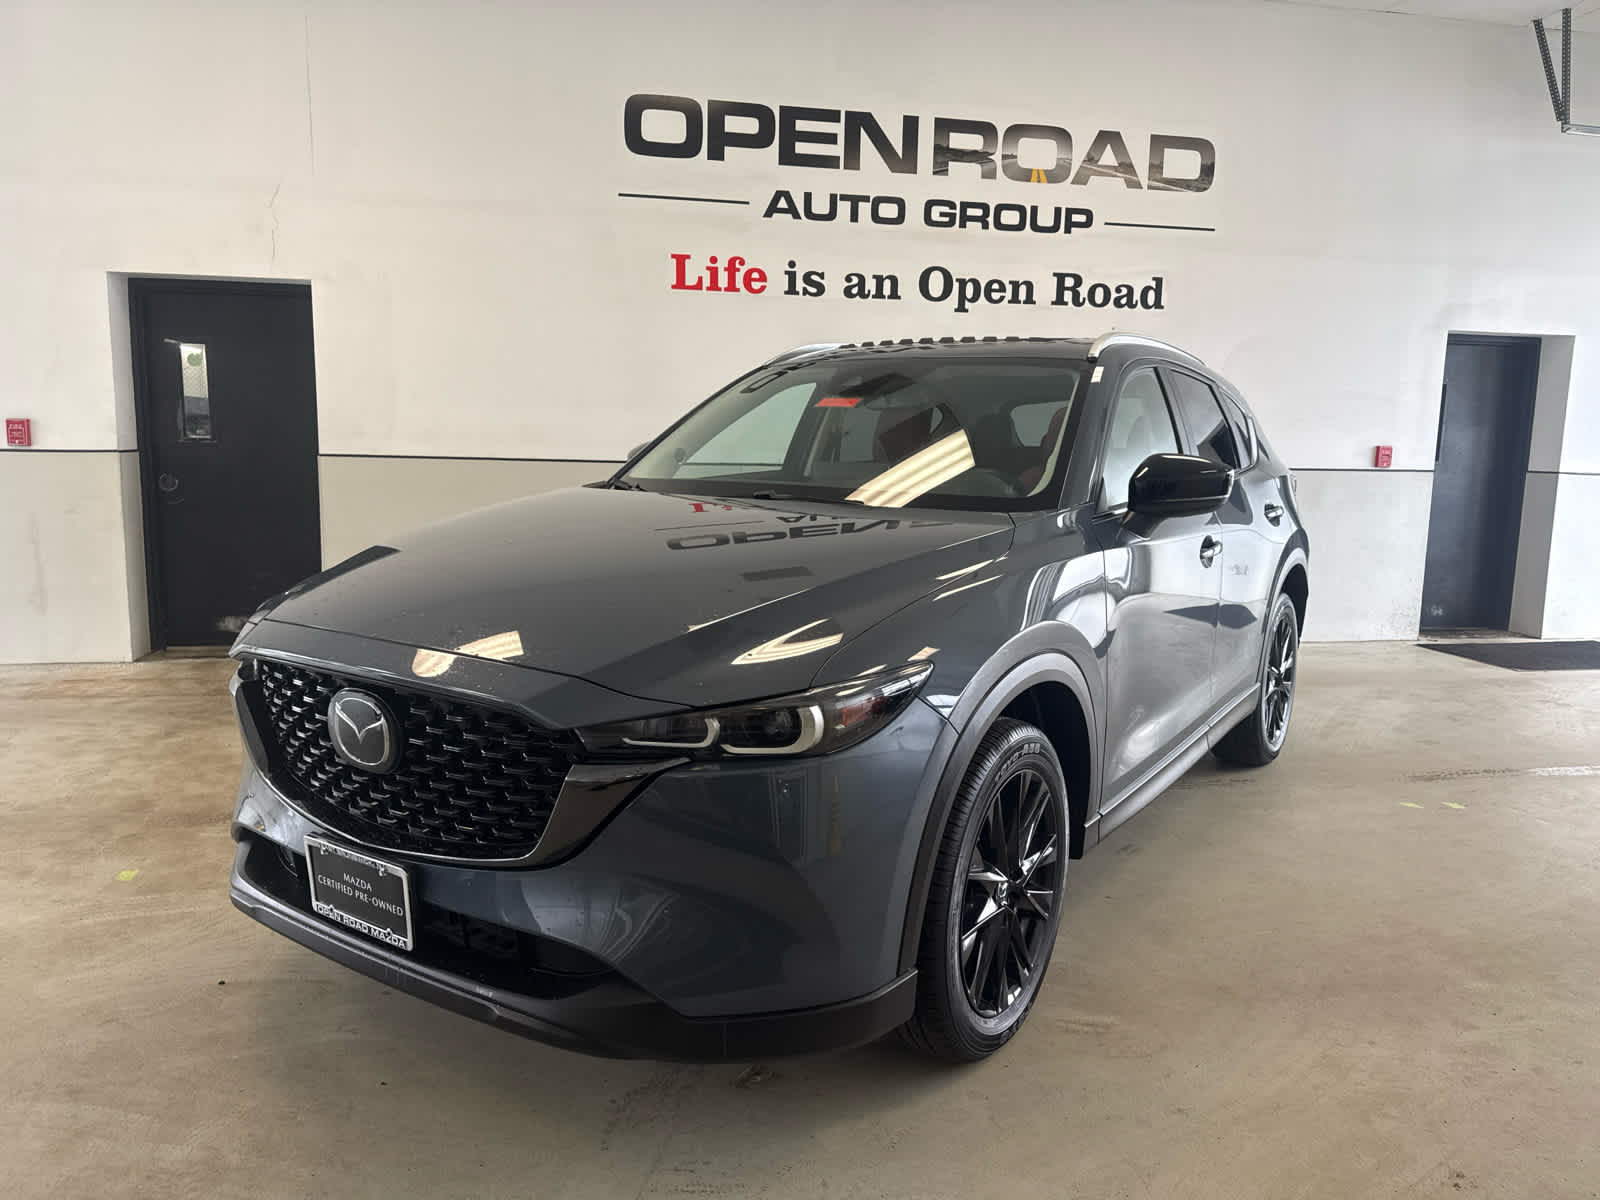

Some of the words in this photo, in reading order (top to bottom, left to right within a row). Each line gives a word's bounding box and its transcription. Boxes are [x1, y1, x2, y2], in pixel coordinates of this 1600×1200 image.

[624, 93, 919, 175] OPEN
[933, 117, 1216, 192] ROAD
[763, 190, 906, 225] AUTO
[924, 199, 1094, 234] GROUP
[671, 254, 767, 294] Life
[784, 260, 826, 298] is
[843, 273, 902, 300] an
[919, 266, 1036, 313] Open
[1051, 272, 1165, 309] Road
[318, 875, 353, 896] CERTIFIED
[355, 890, 403, 916] PRE-OWNED
[343, 873, 372, 891] MAZDA
[316, 903, 341, 922] OPEN
[343, 914, 369, 933] ROAD
[370, 926, 406, 950] MAZDA
